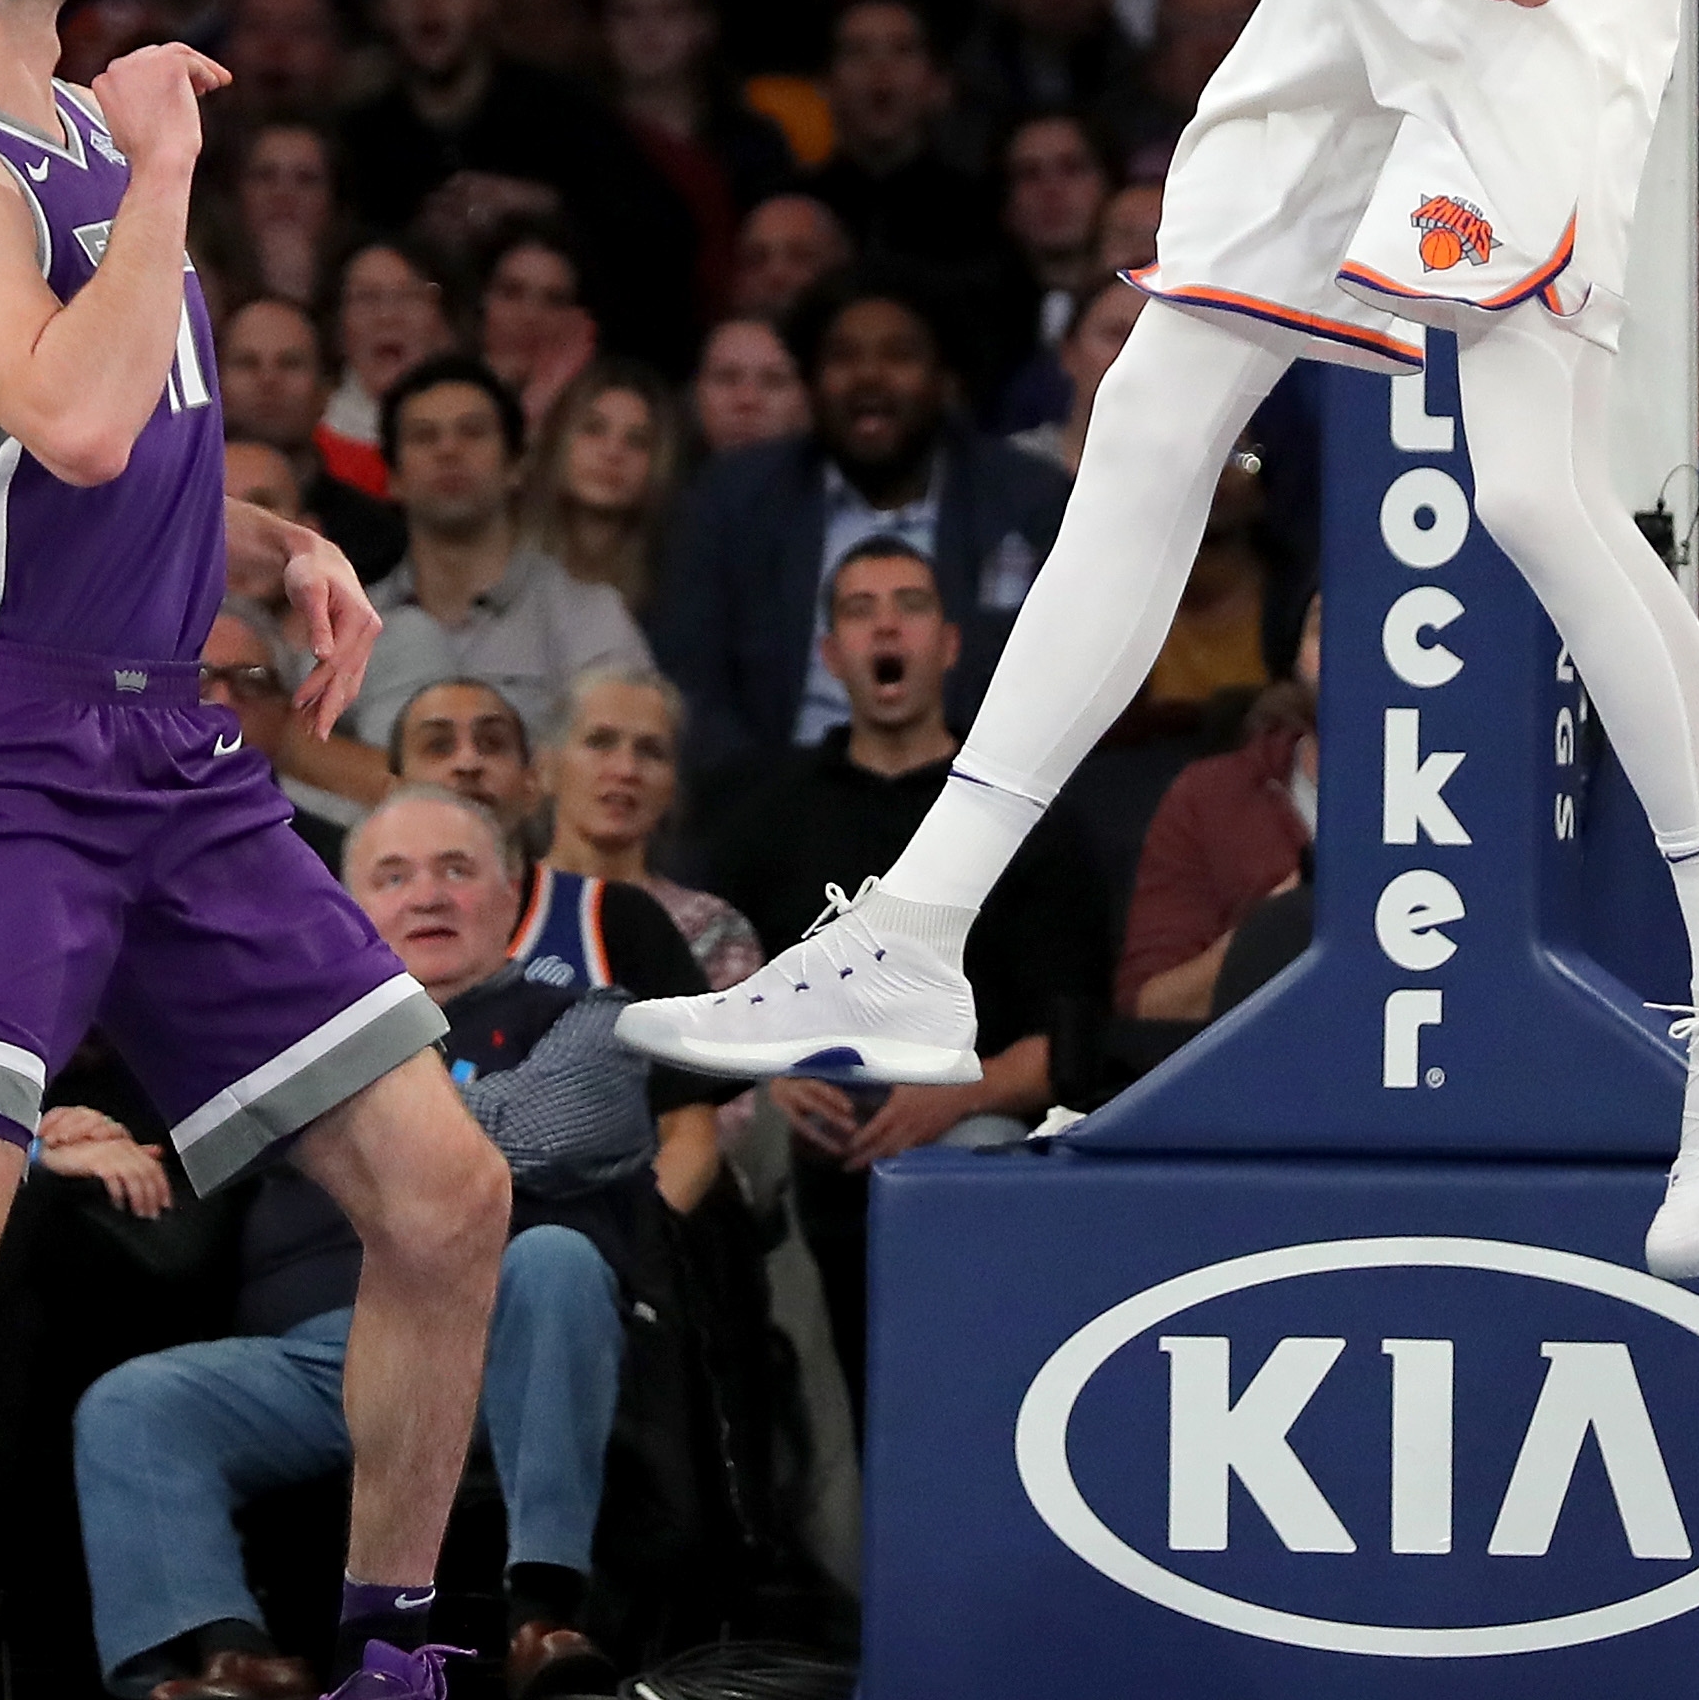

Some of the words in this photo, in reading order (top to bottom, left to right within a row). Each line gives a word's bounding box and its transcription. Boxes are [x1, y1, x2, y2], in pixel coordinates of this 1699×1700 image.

[1410, 195, 1493, 264] KNICKS
[1375, 372, 1473, 1090] Locker
[1160, 1335, 1693, 1559] KIA
